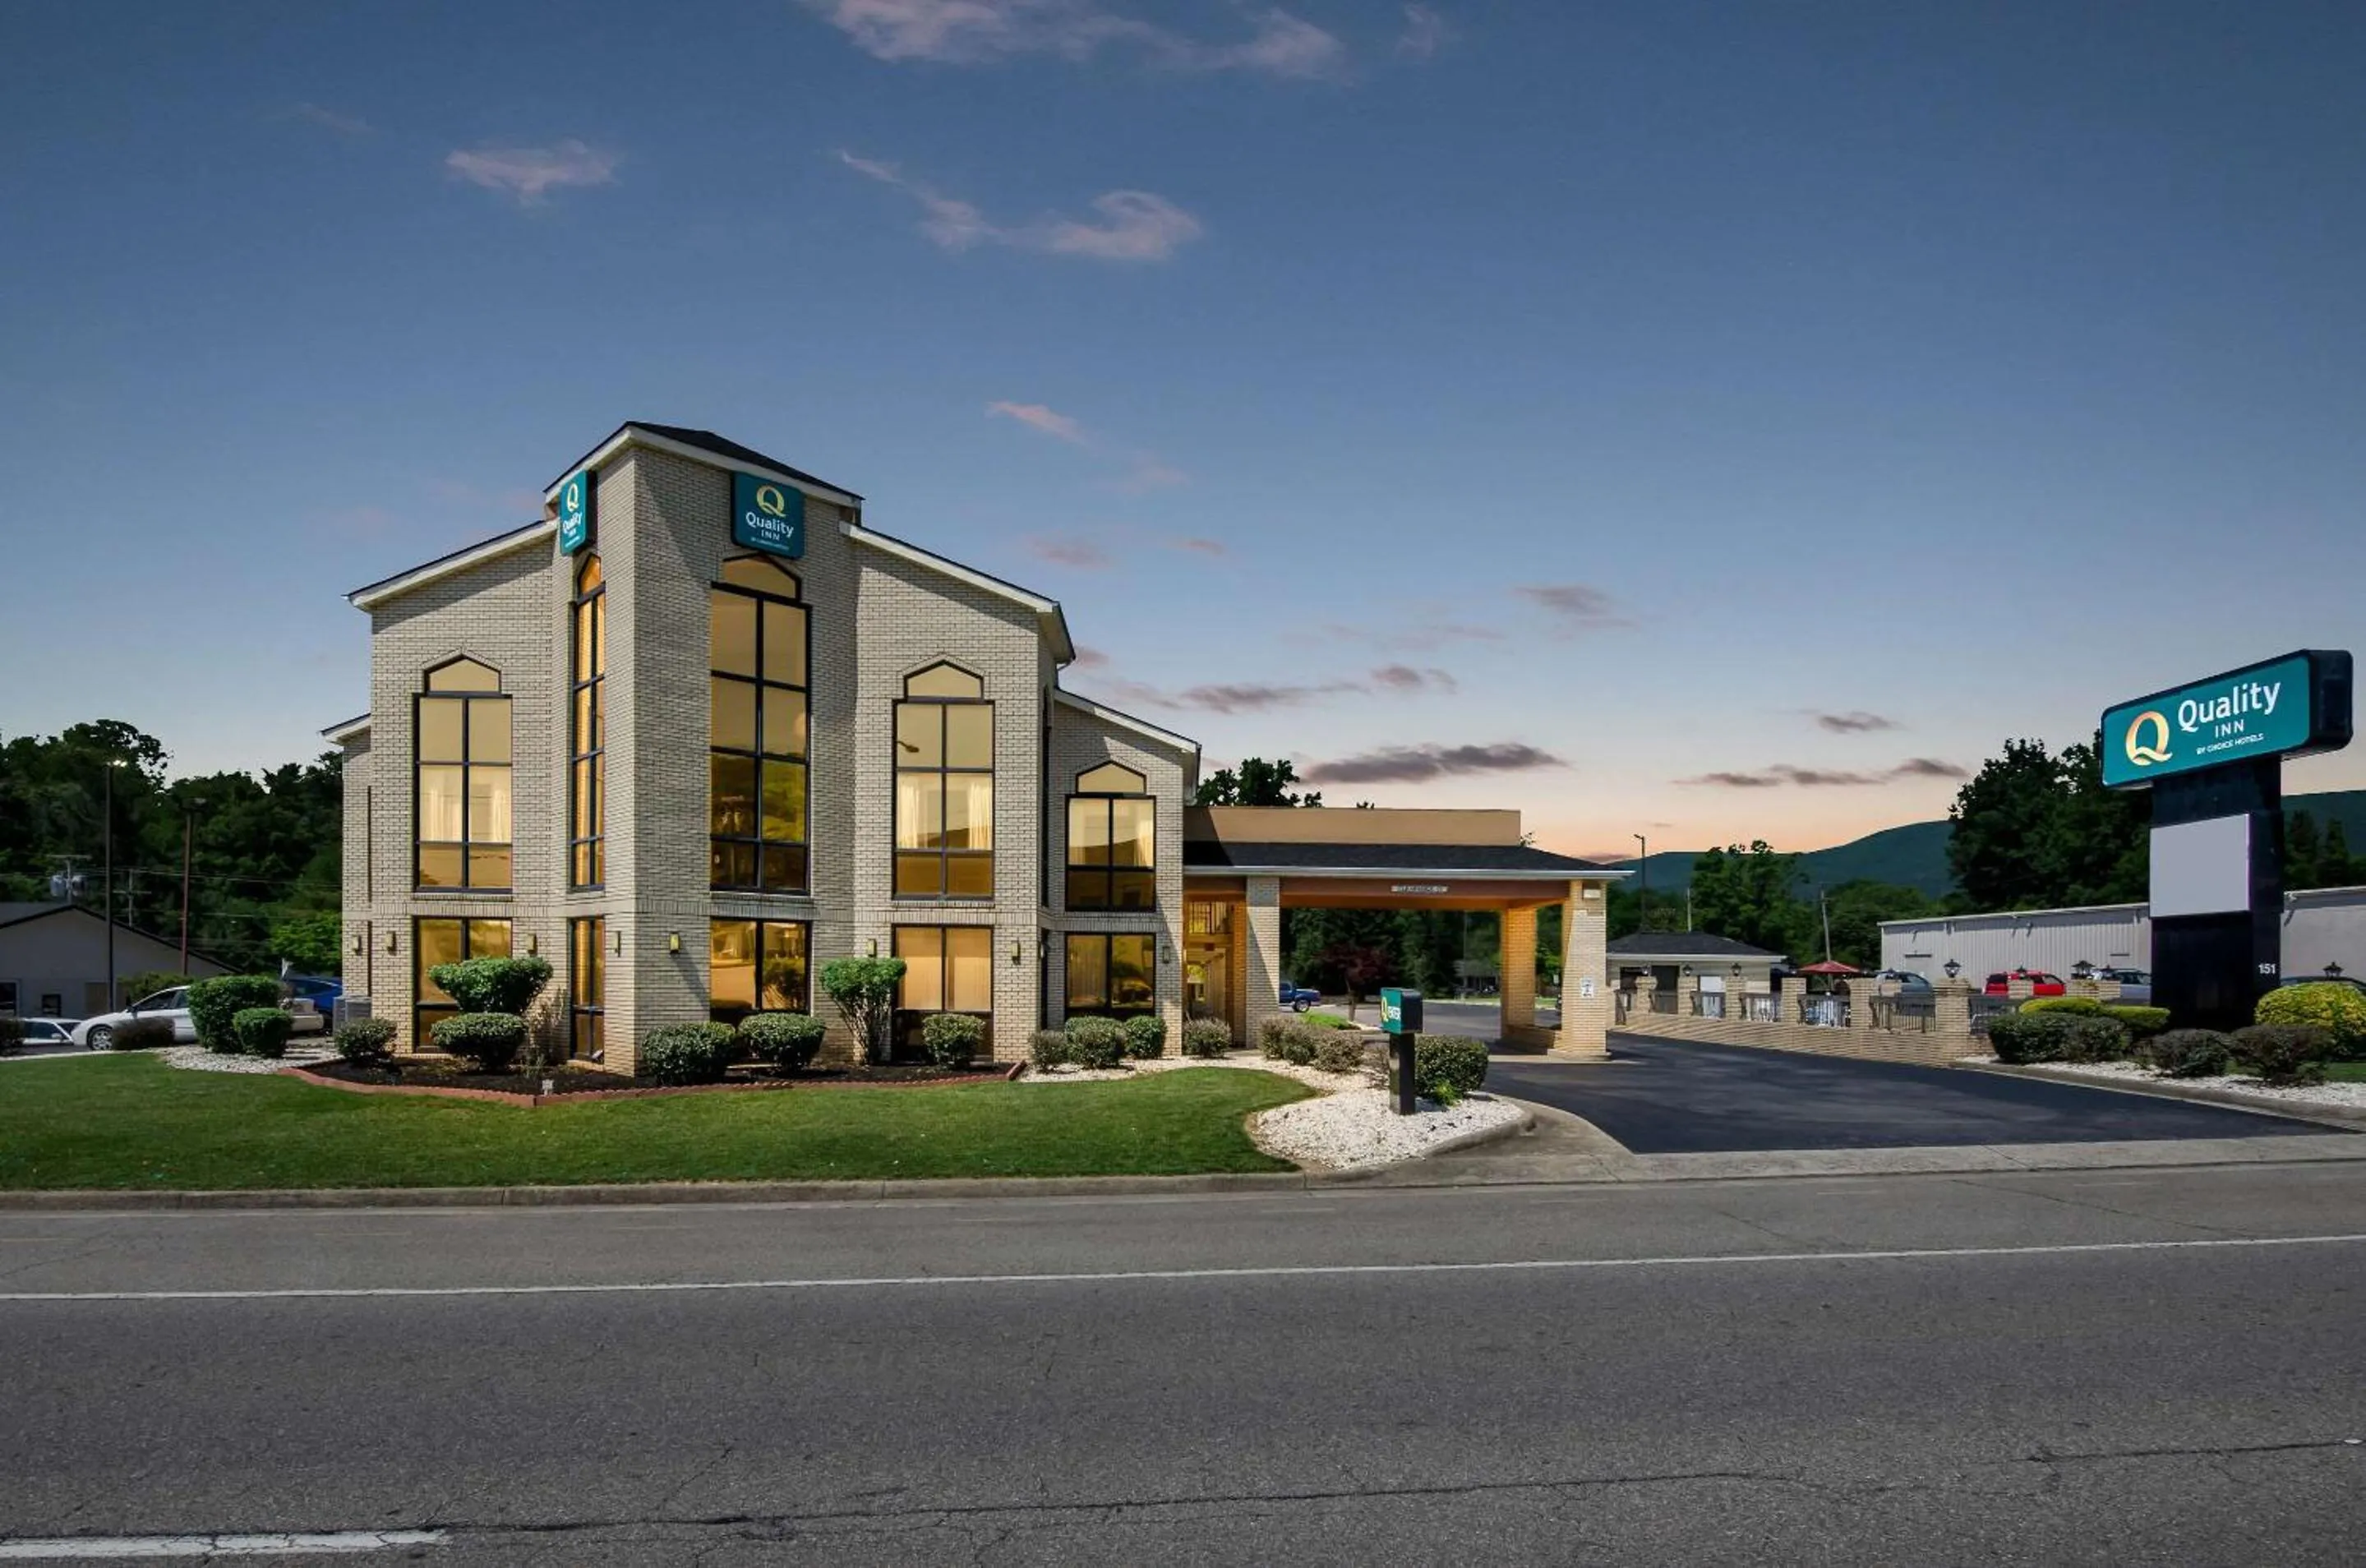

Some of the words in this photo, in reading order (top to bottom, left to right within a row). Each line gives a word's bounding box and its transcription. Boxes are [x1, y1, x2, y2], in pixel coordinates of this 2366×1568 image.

[567, 483, 579, 512] Q
[757, 485, 786, 518] Q
[745, 511, 794, 537] Quality
[761, 529, 780, 541] INN
[2178, 682, 2281, 732] Quality
[2125, 711, 2173, 766] Q
[2215, 719, 2244, 738] INN
[2258, 963, 2276, 974] 151
